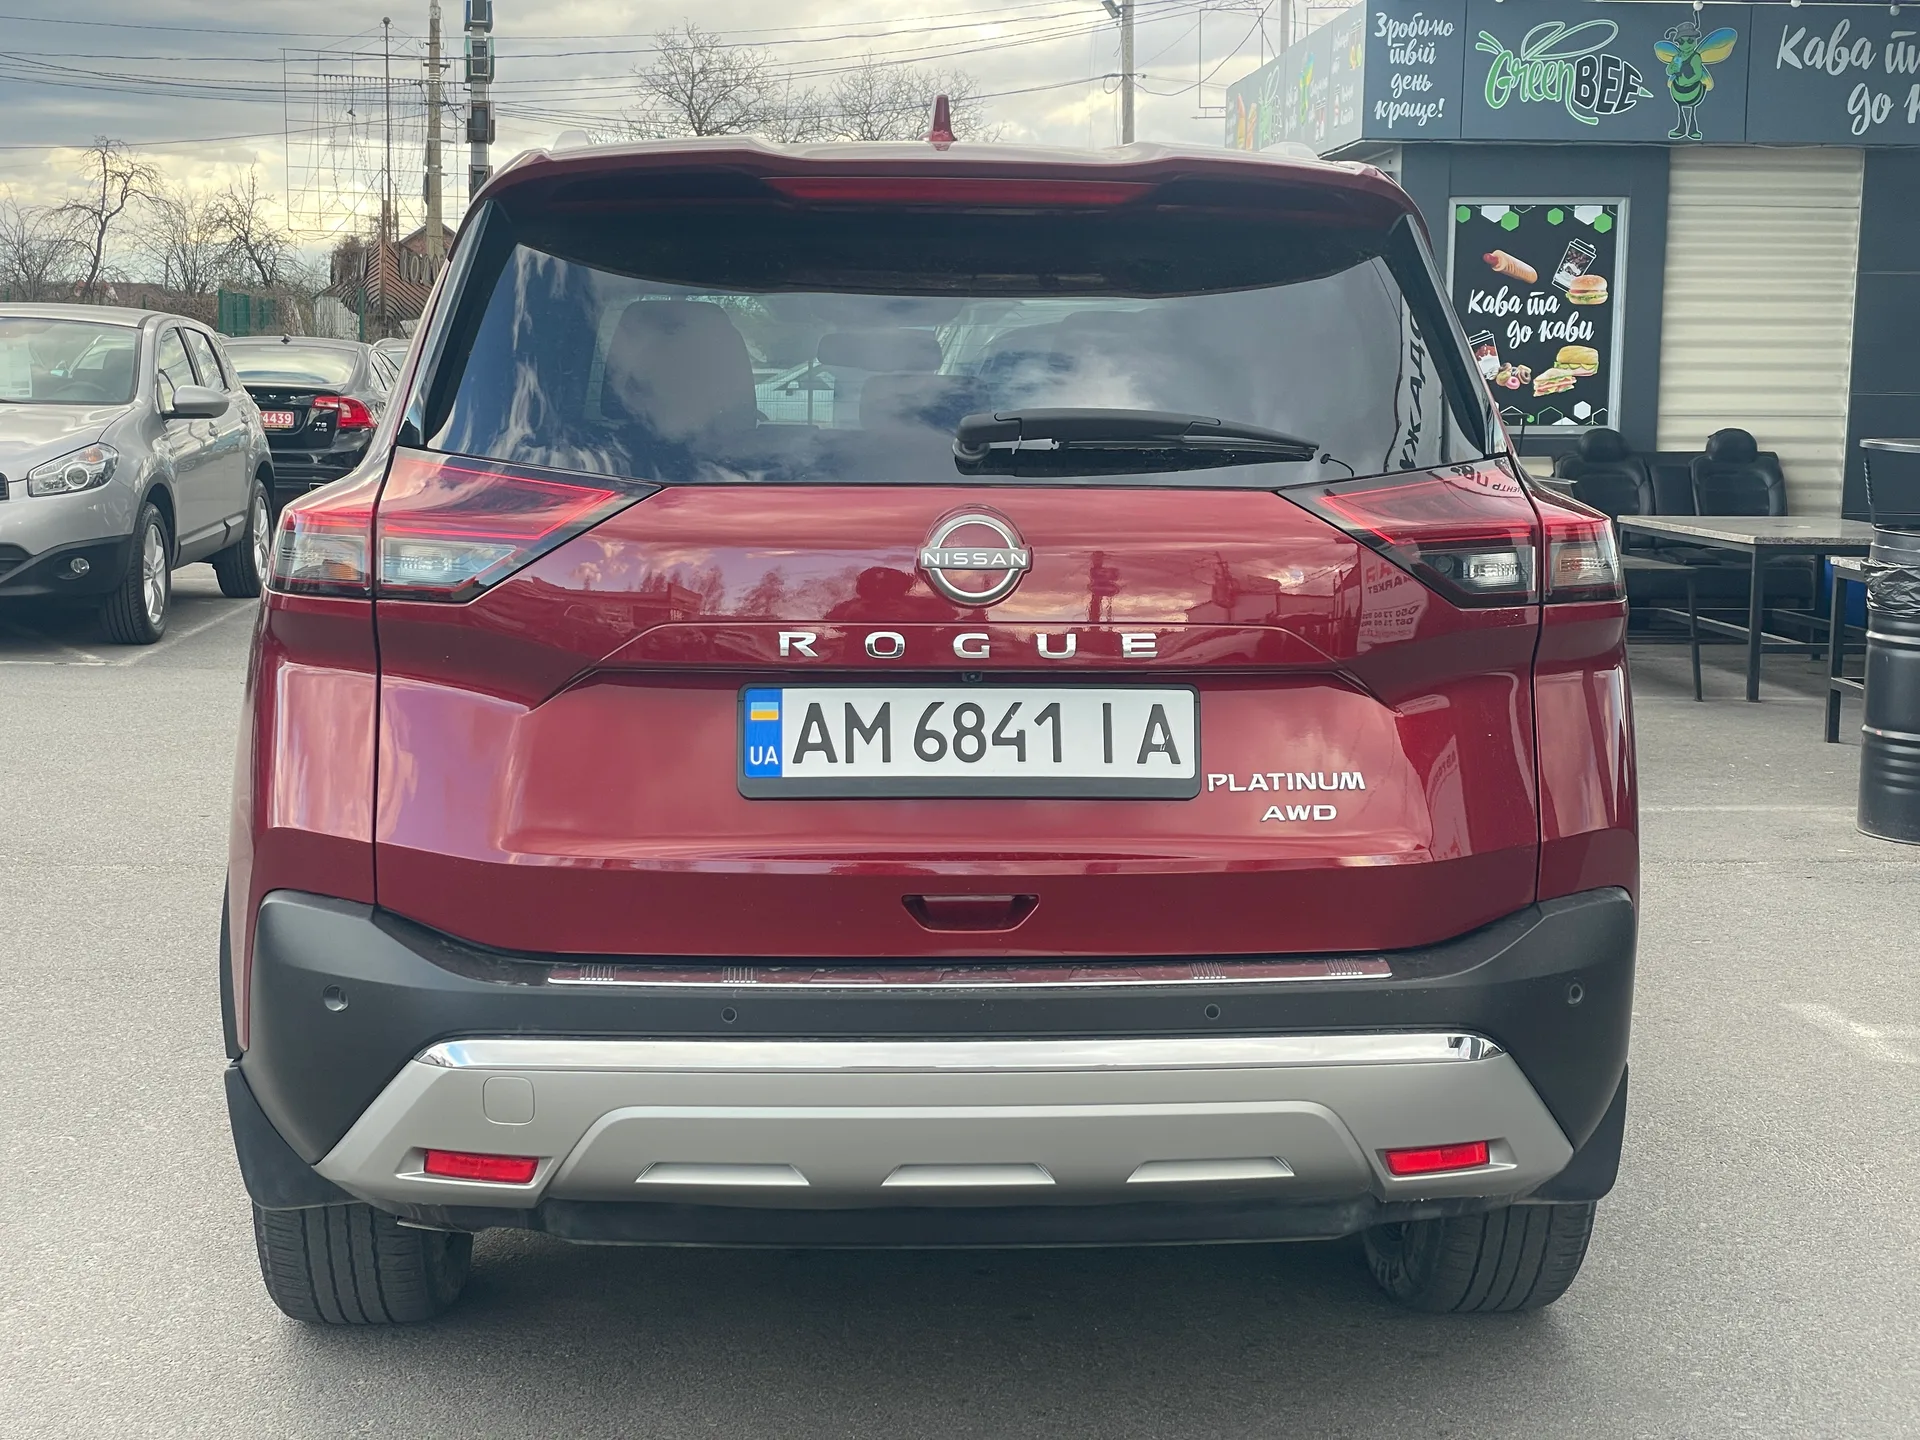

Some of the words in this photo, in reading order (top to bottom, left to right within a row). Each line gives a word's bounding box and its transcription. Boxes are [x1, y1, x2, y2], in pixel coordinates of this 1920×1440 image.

[1374, 12, 1455, 46] Зробимо
[1389, 38, 1437, 65] твій
[1776, 18, 1877, 76] Кава
[1390, 72, 1433, 98] день
[1374, 98, 1446, 129] краще!
[1847, 82, 1895, 136] до
[1468, 285, 1523, 317] Кава
[1527, 291, 1560, 316] та
[1507, 319, 1533, 349] до
[1539, 311, 1594, 343] кави
[924, 552, 1027, 566] NISSAN
[778, 631, 1158, 659] ROGUE
[792, 702, 891, 763] AM
[913, 702, 1062, 763] 6841
[750, 747, 779, 765] UA
[1207, 771, 1366, 792] PLATINUM
[1260, 804, 1337, 822] AWD
